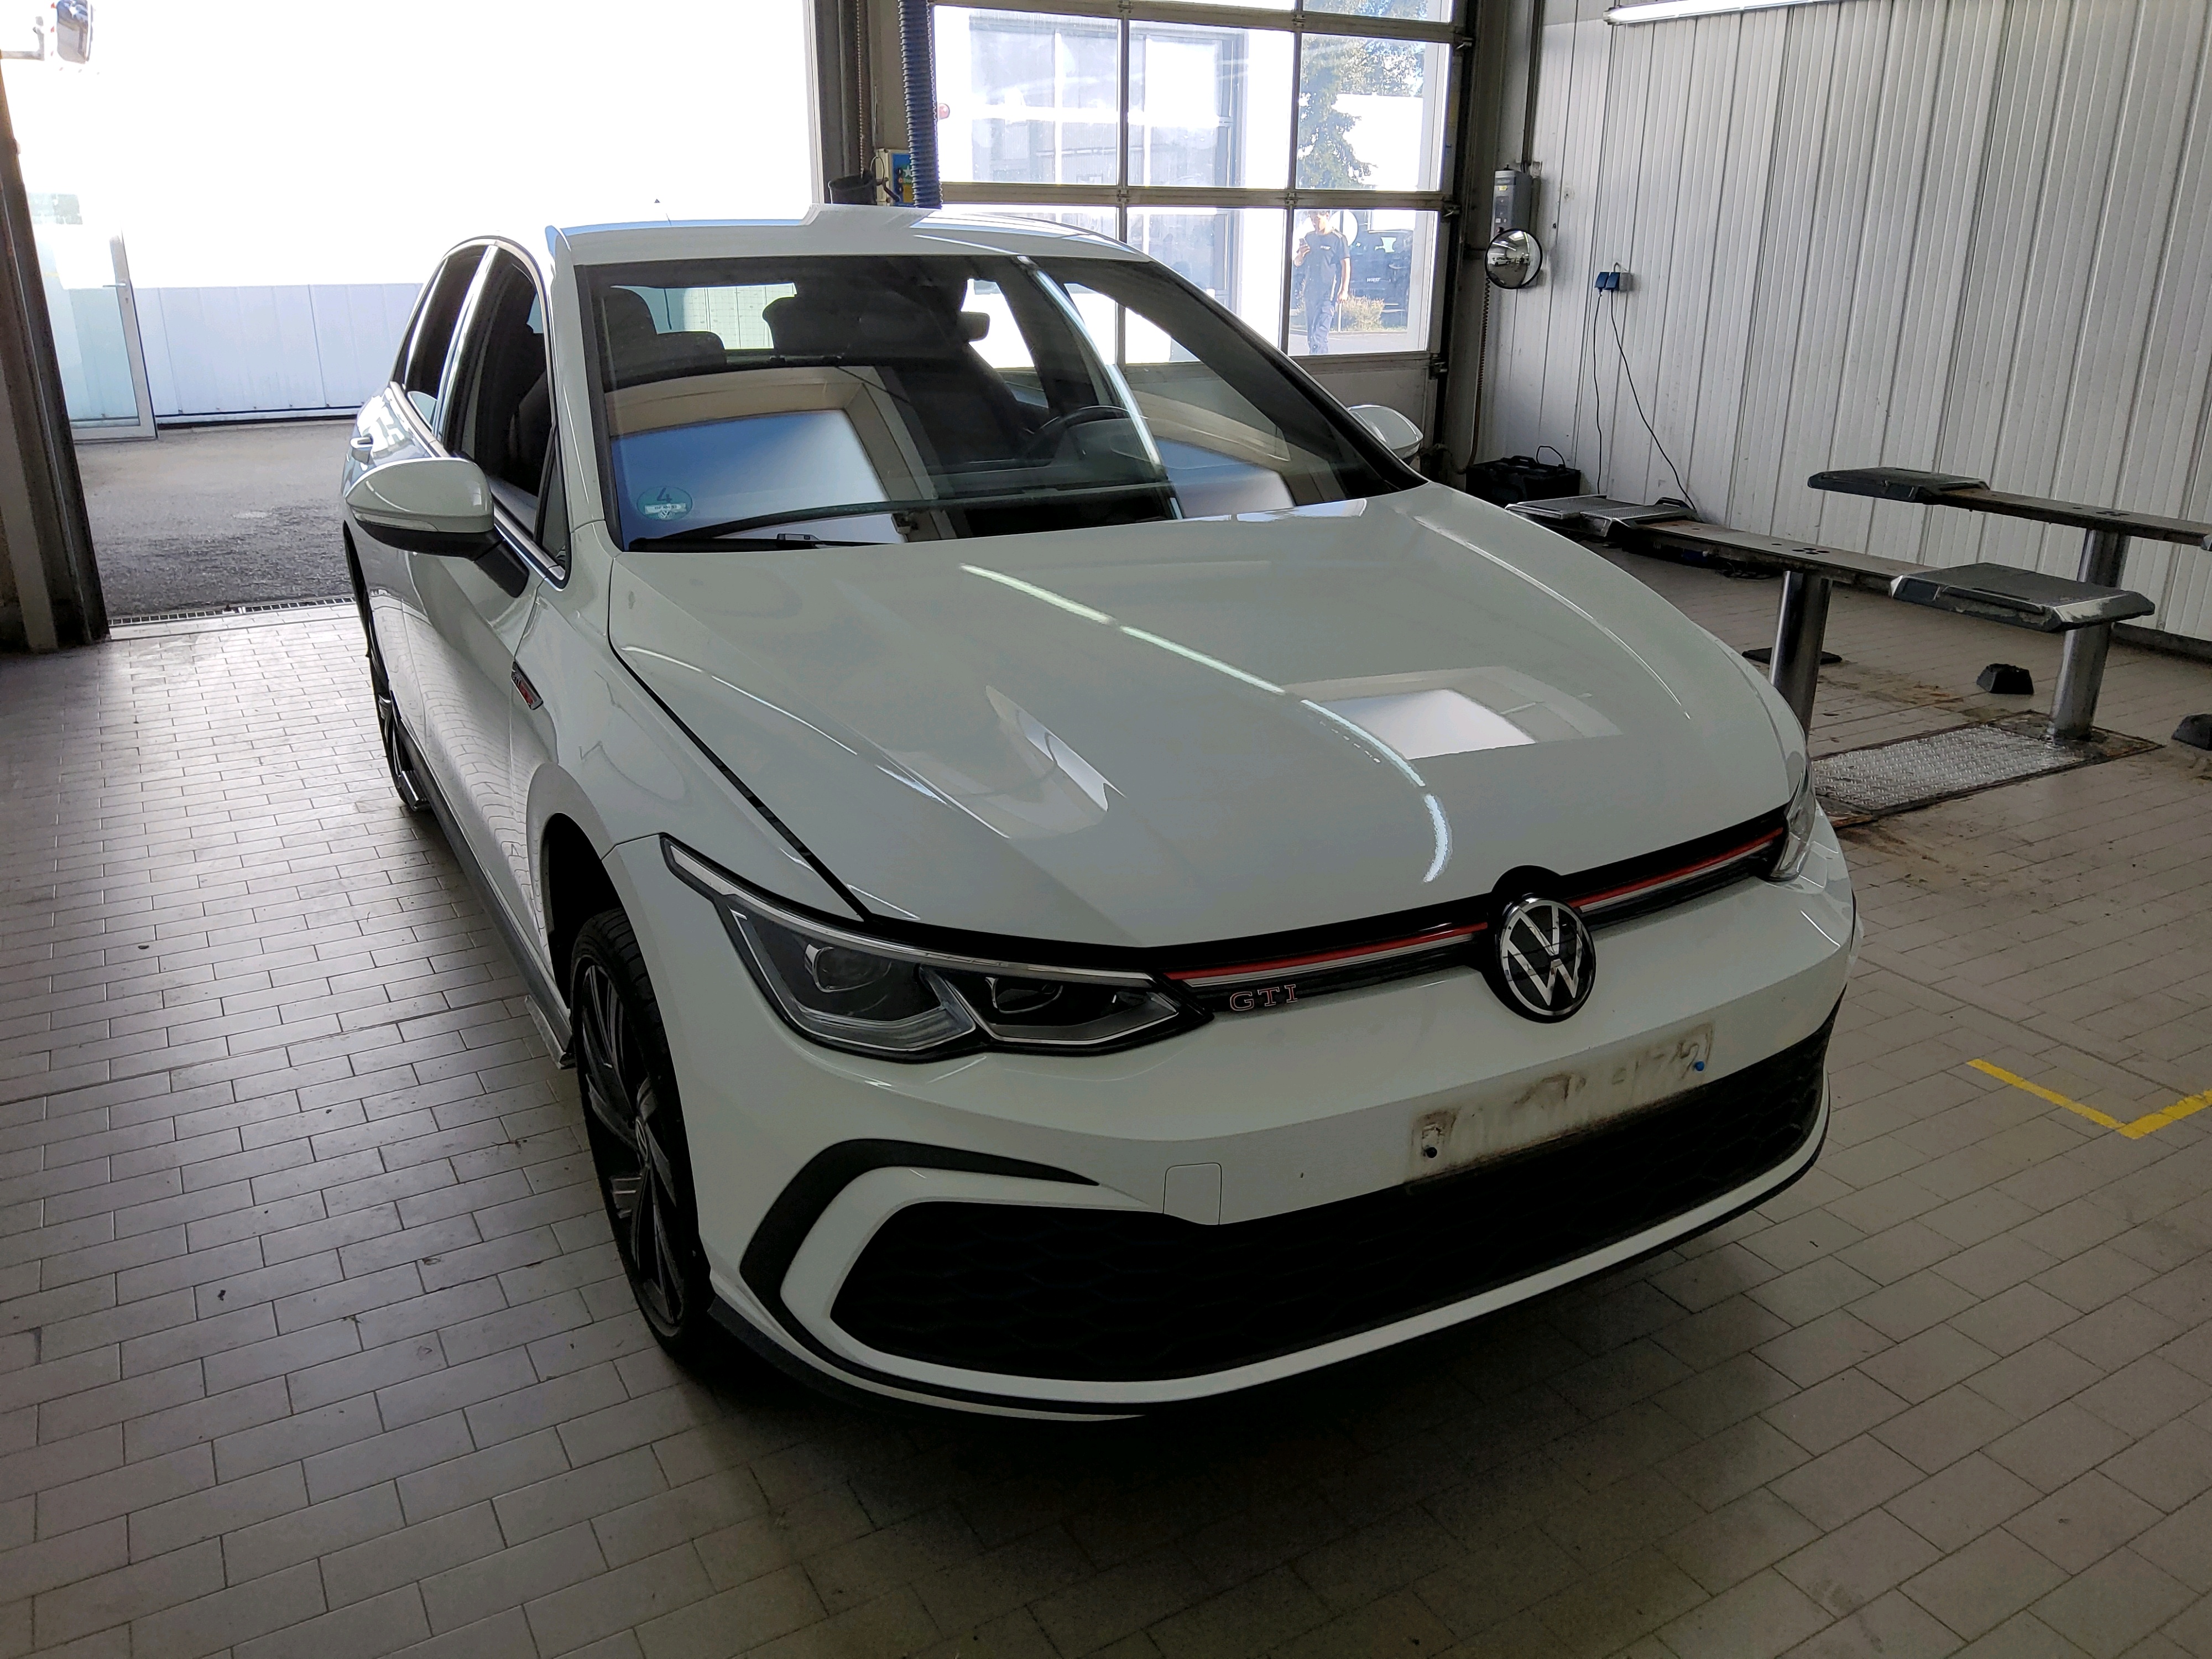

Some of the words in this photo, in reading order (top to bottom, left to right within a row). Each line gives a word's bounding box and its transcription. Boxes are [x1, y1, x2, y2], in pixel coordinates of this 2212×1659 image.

[656, 487, 672, 502] 4
[1501, 901, 1584, 1009] VW
[1230, 984, 1298, 1011] GTI
